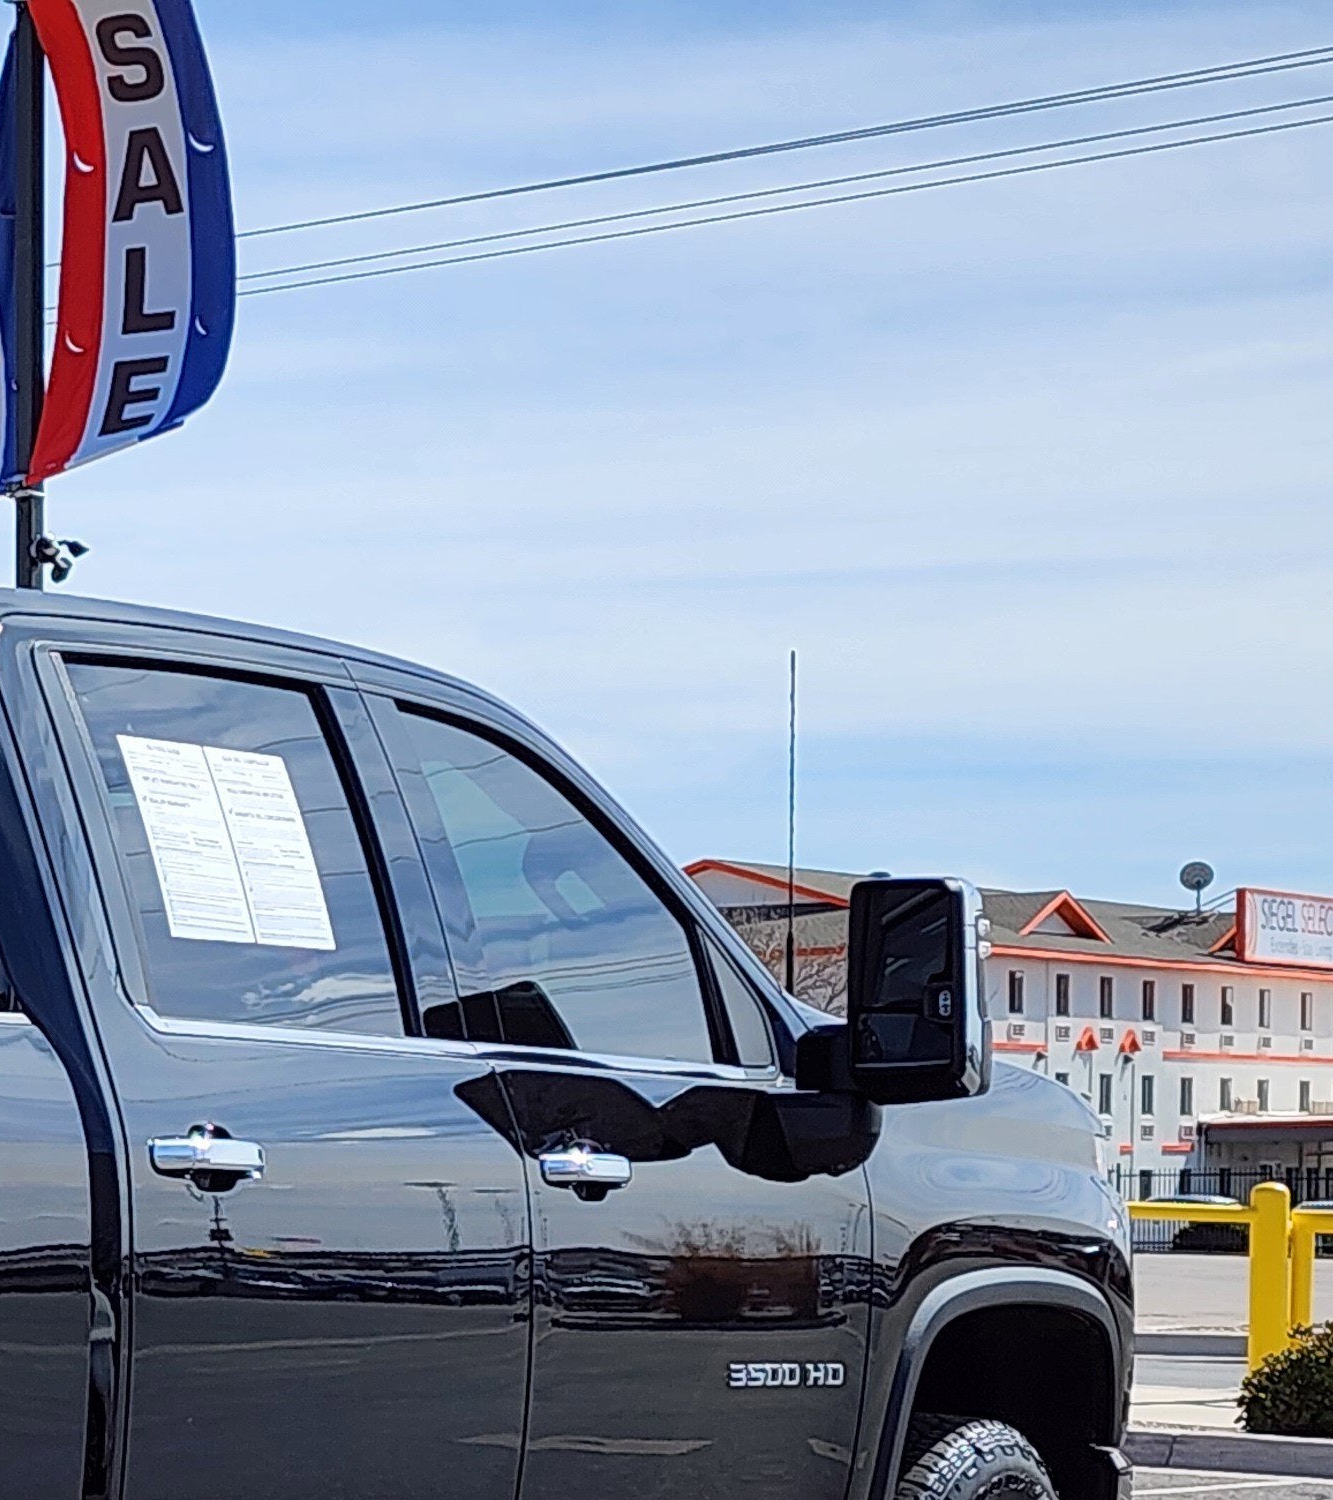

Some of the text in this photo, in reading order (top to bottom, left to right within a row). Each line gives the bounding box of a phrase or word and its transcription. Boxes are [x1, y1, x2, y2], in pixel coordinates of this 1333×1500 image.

[95, 13, 185, 437] SALE
[729, 1363, 844, 1387] 3500 HD
